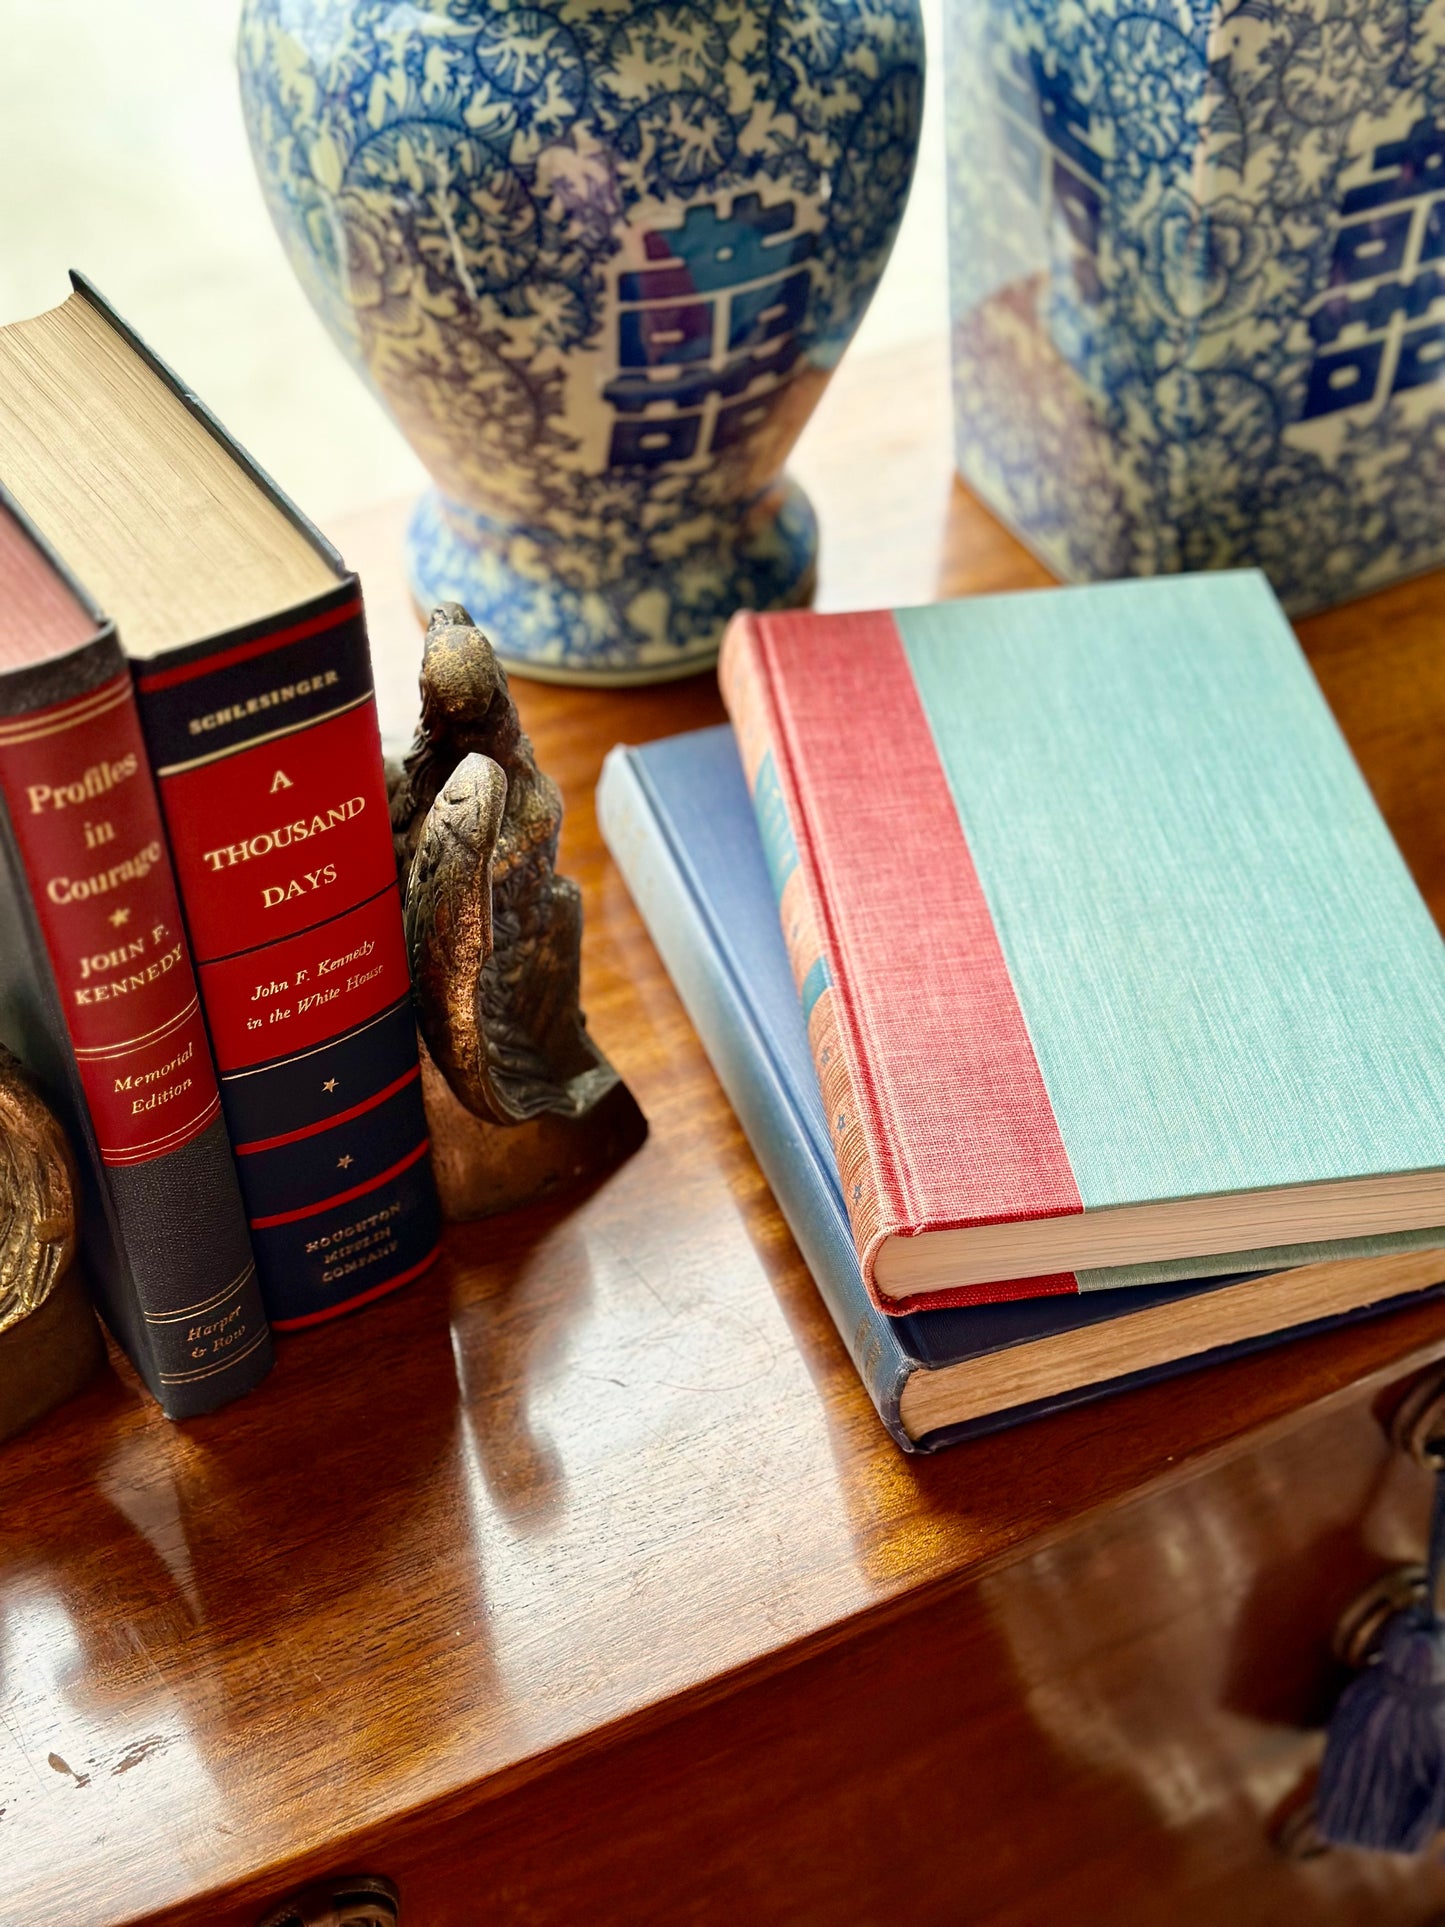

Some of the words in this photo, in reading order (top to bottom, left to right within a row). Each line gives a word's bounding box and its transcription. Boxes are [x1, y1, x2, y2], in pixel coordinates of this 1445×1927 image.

[188, 669, 339, 736] SCHLESINGER
[27, 753, 138, 814] Profiles
[269, 769, 293, 794] A
[84, 822, 115, 849] in
[203, 796, 366, 871] THOUSAND
[47, 841, 161, 905] Courage
[261, 863, 338, 908] DAYS
[74, 942, 183, 1006] KENNEDY
[79, 938, 145, 979] JOHN
[152, 924, 170, 945] F.
[250, 981, 289, 1001] John
[295, 969, 311, 986] F.
[317, 940, 376, 976] Kennedy
[246, 1018, 263, 1030] in
[269, 1008, 291, 1024] the
[297, 987, 341, 1015] White
[345, 964, 384, 993] House
[114, 1042, 194, 1092] Memorial
[131, 1078, 193, 1115] Edition
[187, 1305, 242, 1342] Harper
[212, 1325, 247, 1353] Row
